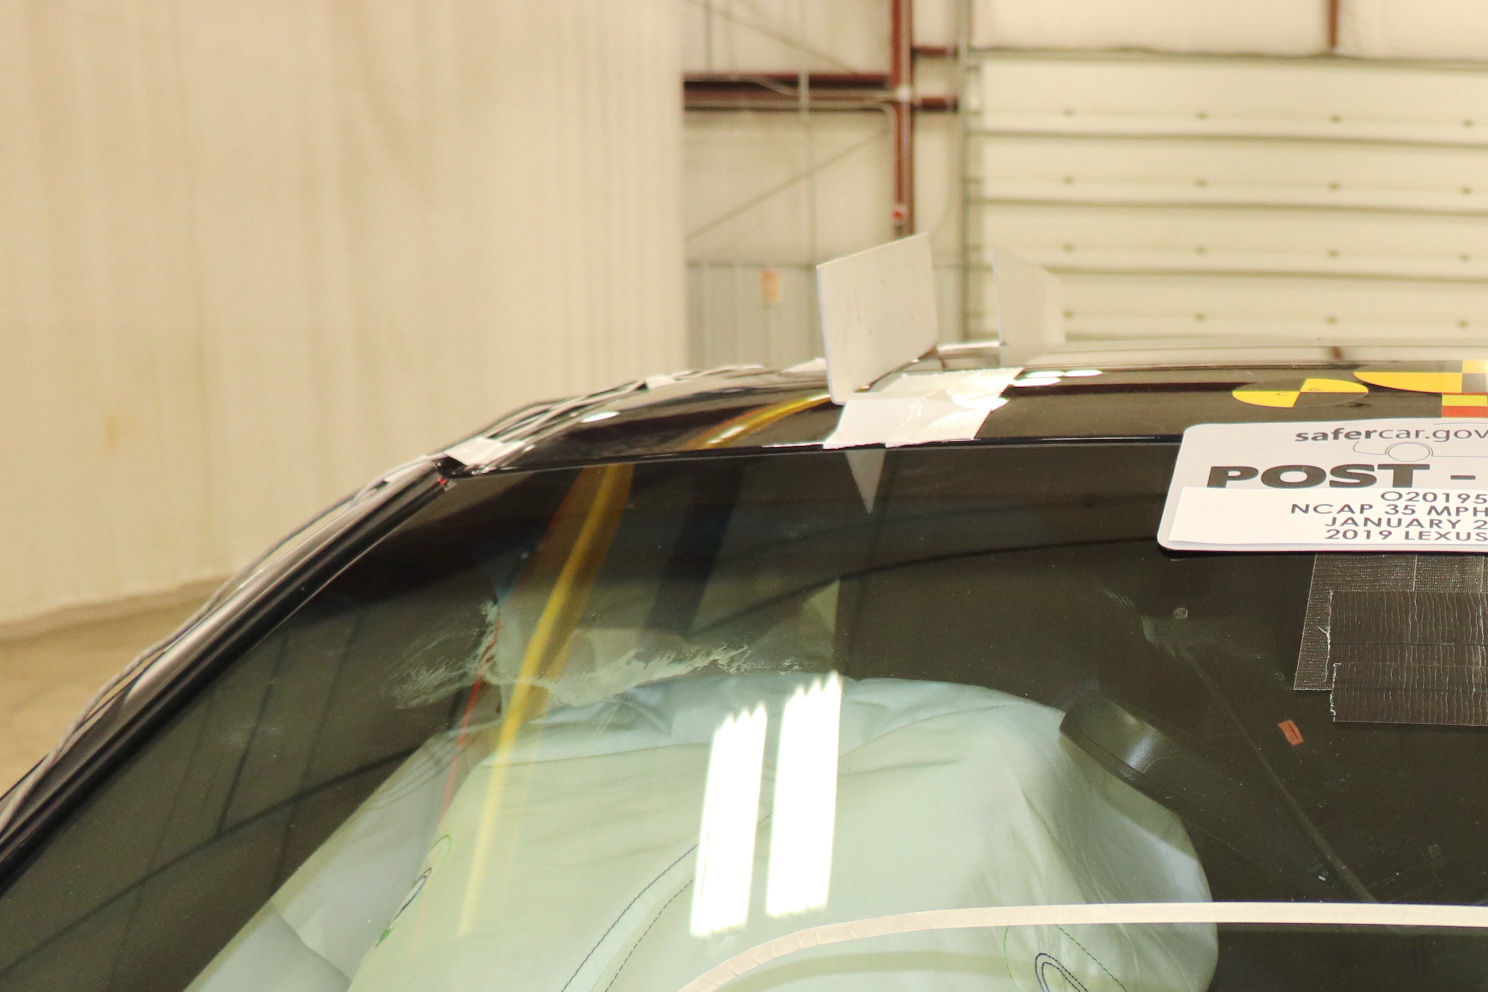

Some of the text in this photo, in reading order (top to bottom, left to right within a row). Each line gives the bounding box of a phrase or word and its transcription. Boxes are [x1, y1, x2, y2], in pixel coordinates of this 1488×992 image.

[1206, 463, 1430, 488] POST
[1290, 503, 1375, 515] NCAP
[1384, 504, 1416, 516] 35
[1324, 517, 1463, 529] JANUARY
[1324, 529, 1393, 540] 2019
[1404, 530, 1488, 542] LEXUS
